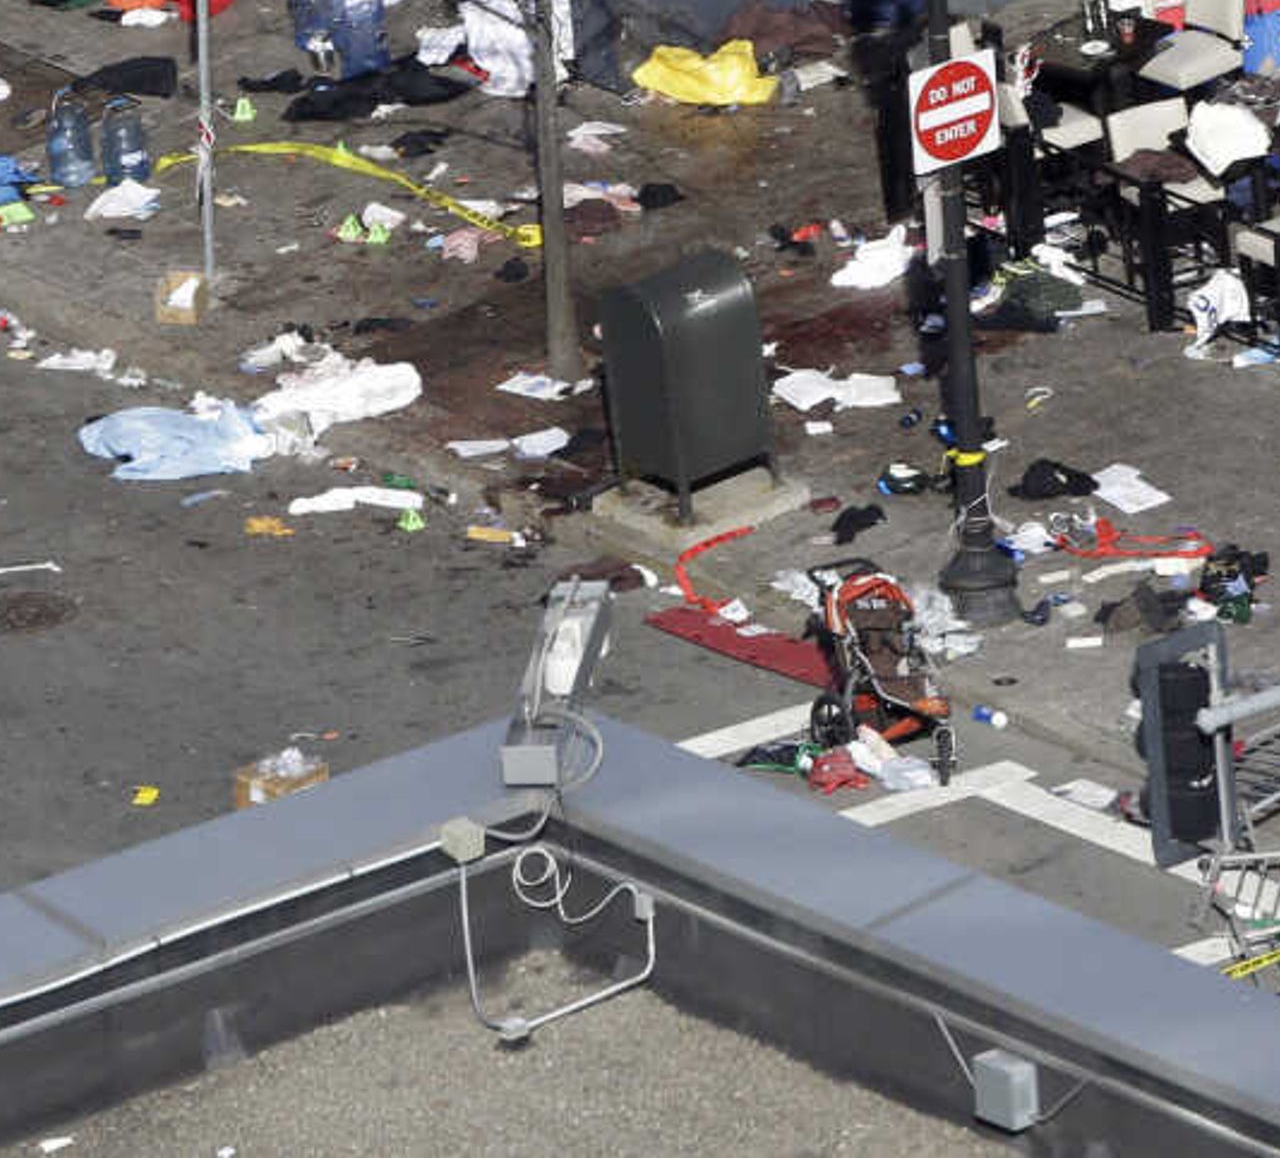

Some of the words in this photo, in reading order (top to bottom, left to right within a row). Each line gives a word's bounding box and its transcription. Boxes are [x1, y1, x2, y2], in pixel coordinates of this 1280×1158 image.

[928, 85, 949, 105] DO
[951, 75, 976, 99] NOT
[934, 119, 977, 146] ENTER
